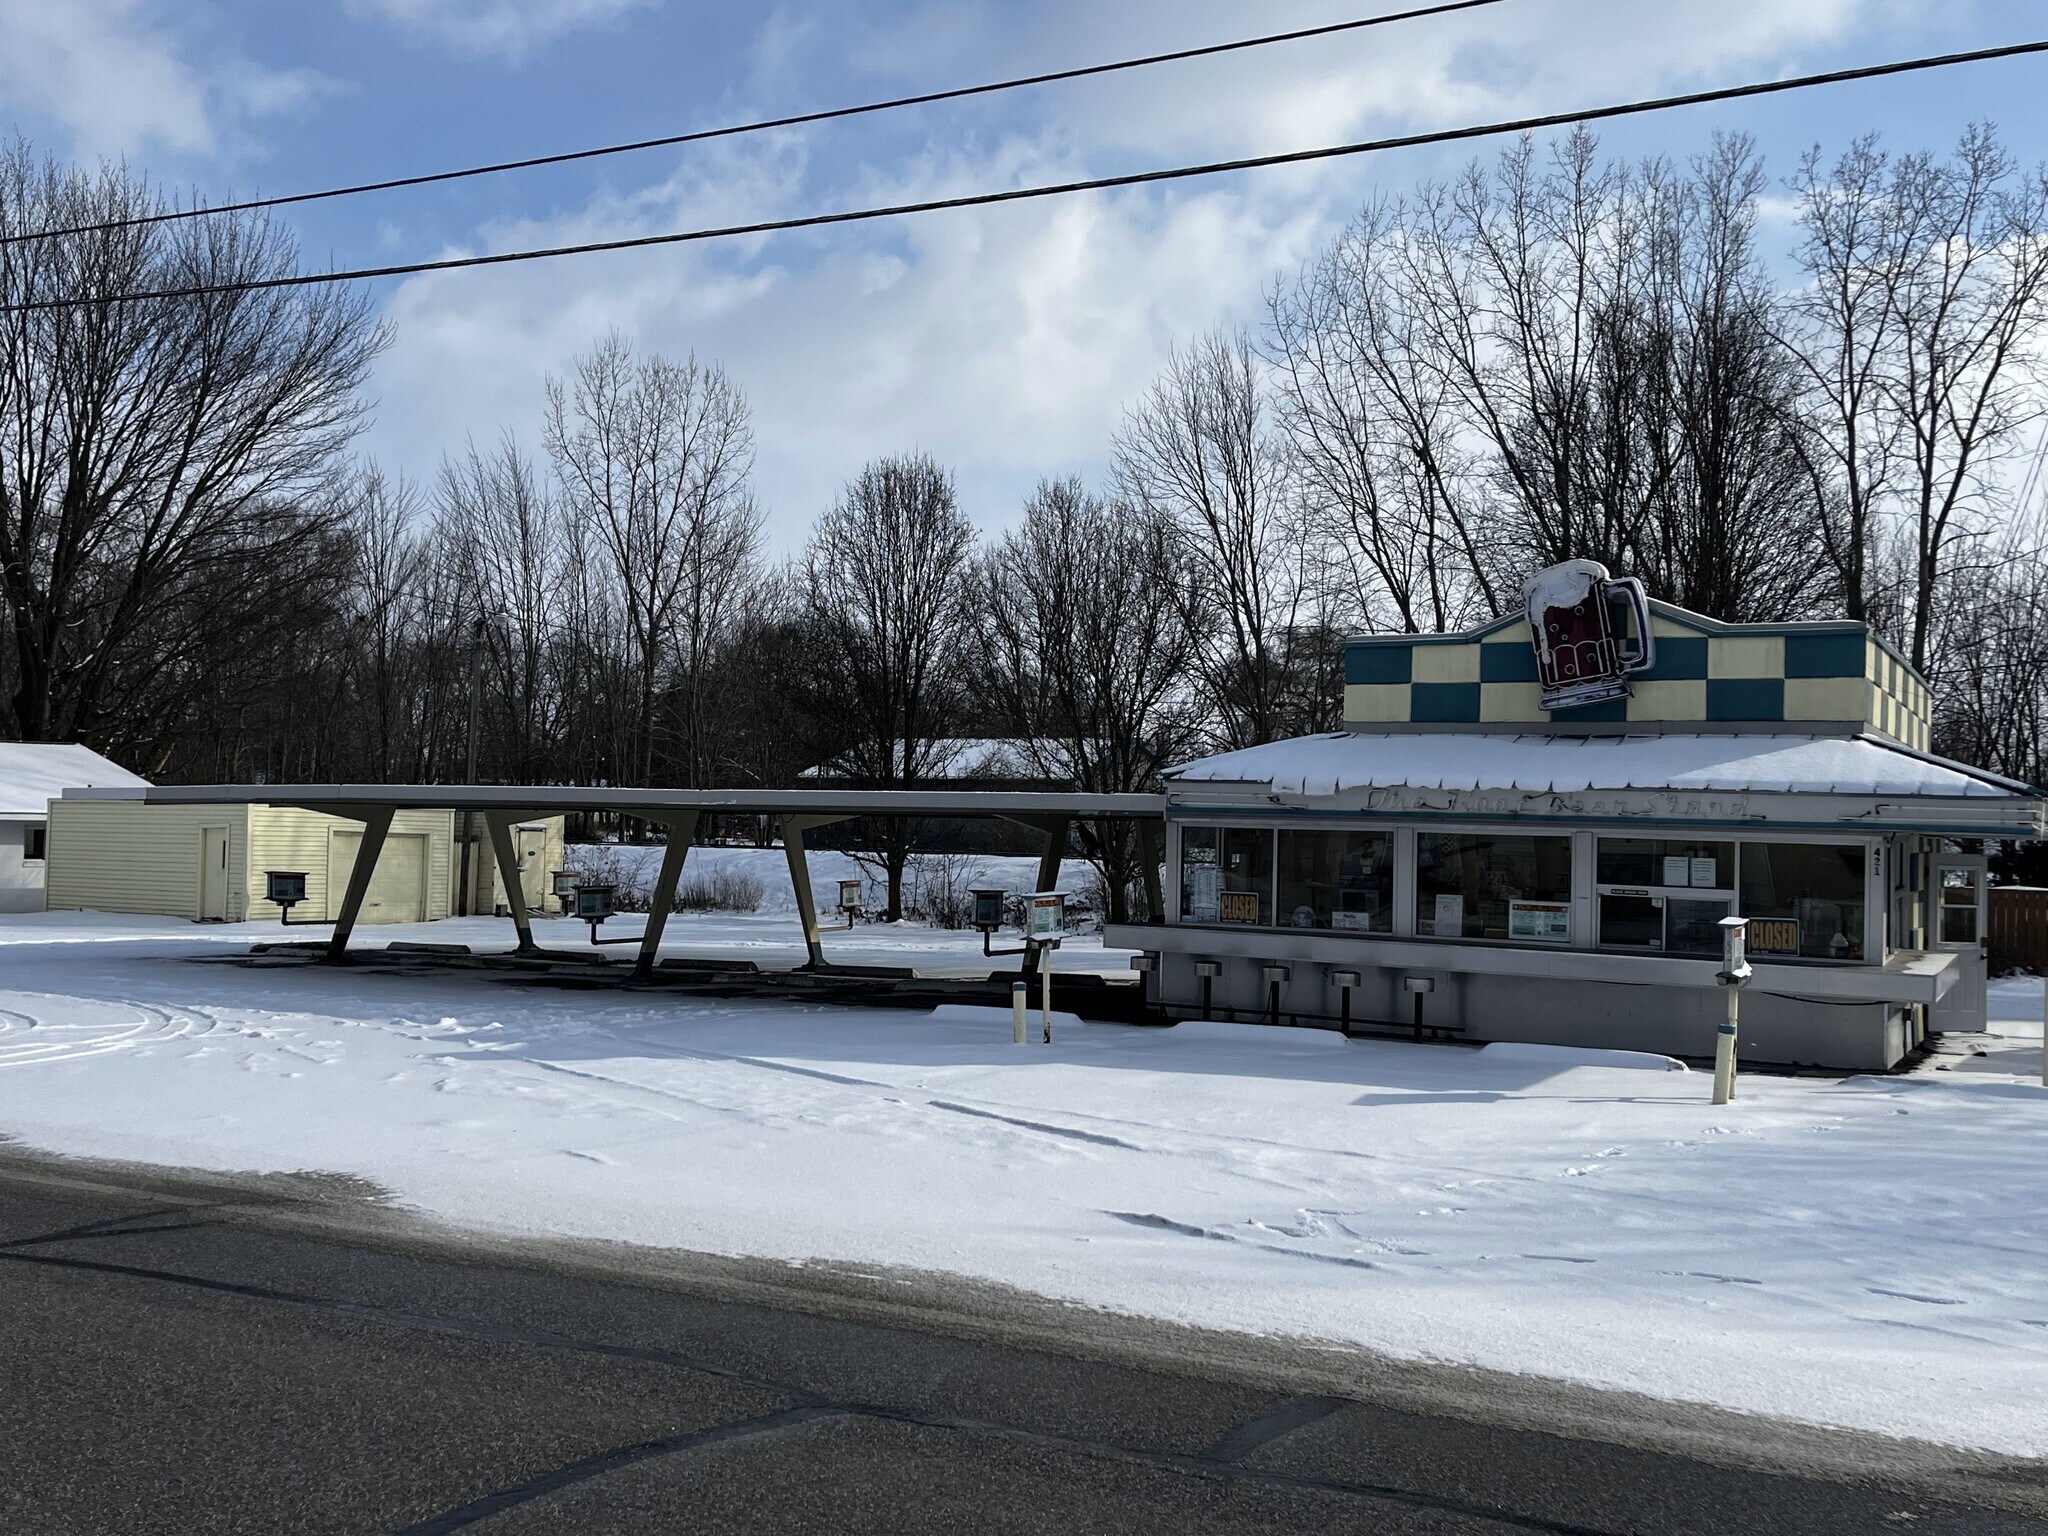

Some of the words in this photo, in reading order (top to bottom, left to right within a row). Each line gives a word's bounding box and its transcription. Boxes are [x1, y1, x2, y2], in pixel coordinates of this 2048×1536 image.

[1646, 792, 1748, 818] Stand
[1221, 895, 1256, 920] CLOSED
[1751, 921, 1797, 951] CLOSED
